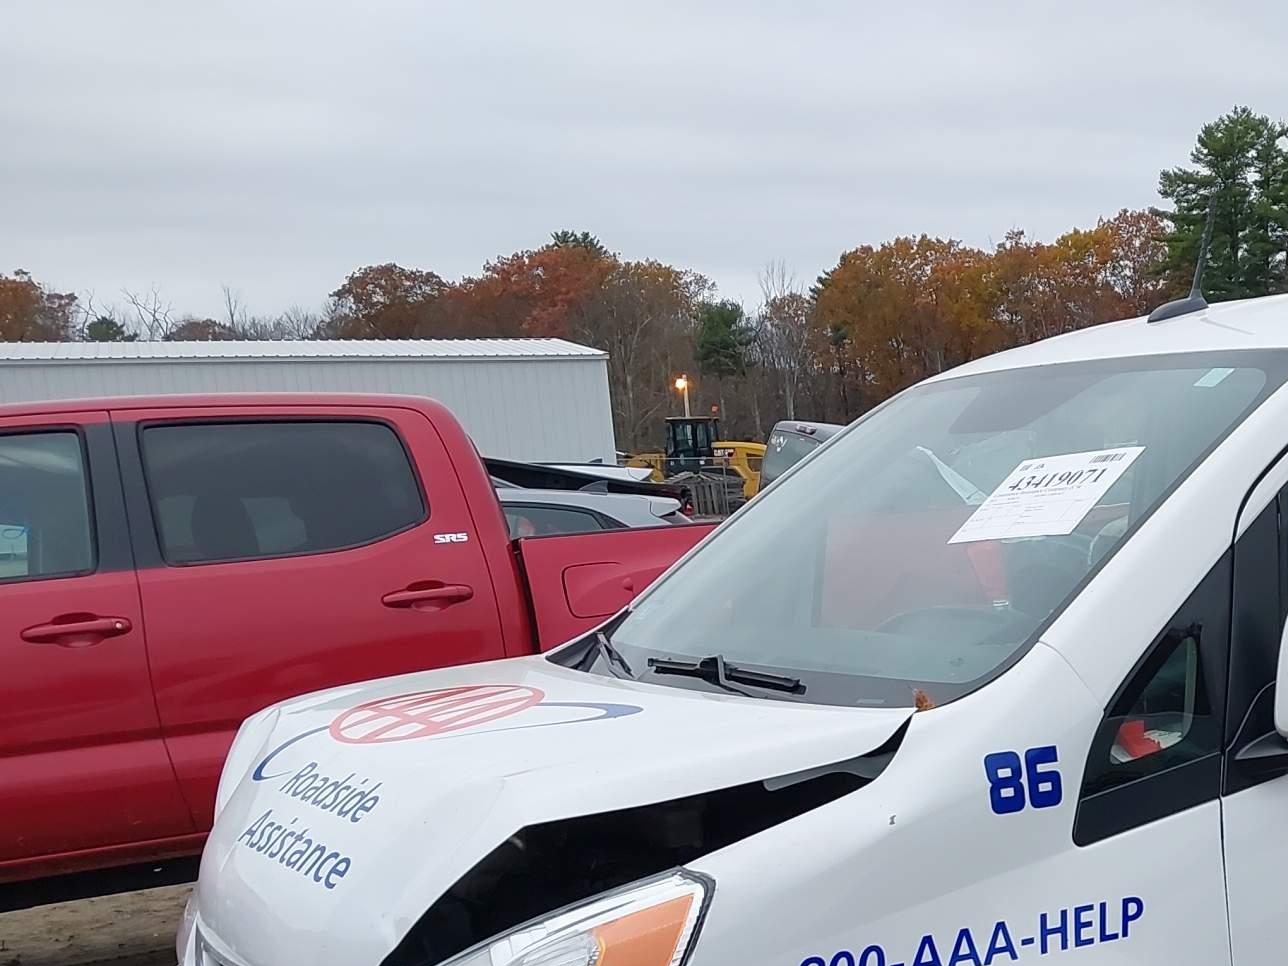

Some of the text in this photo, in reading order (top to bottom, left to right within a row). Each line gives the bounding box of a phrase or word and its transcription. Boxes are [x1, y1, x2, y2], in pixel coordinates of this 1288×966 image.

[1008, 467, 1108, 492] 43419071
[433, 532, 469, 544] SR5
[280, 761, 384, 823] Roadside
[983, 745, 1063, 815] 86
[237, 808, 352, 890] Assistance
